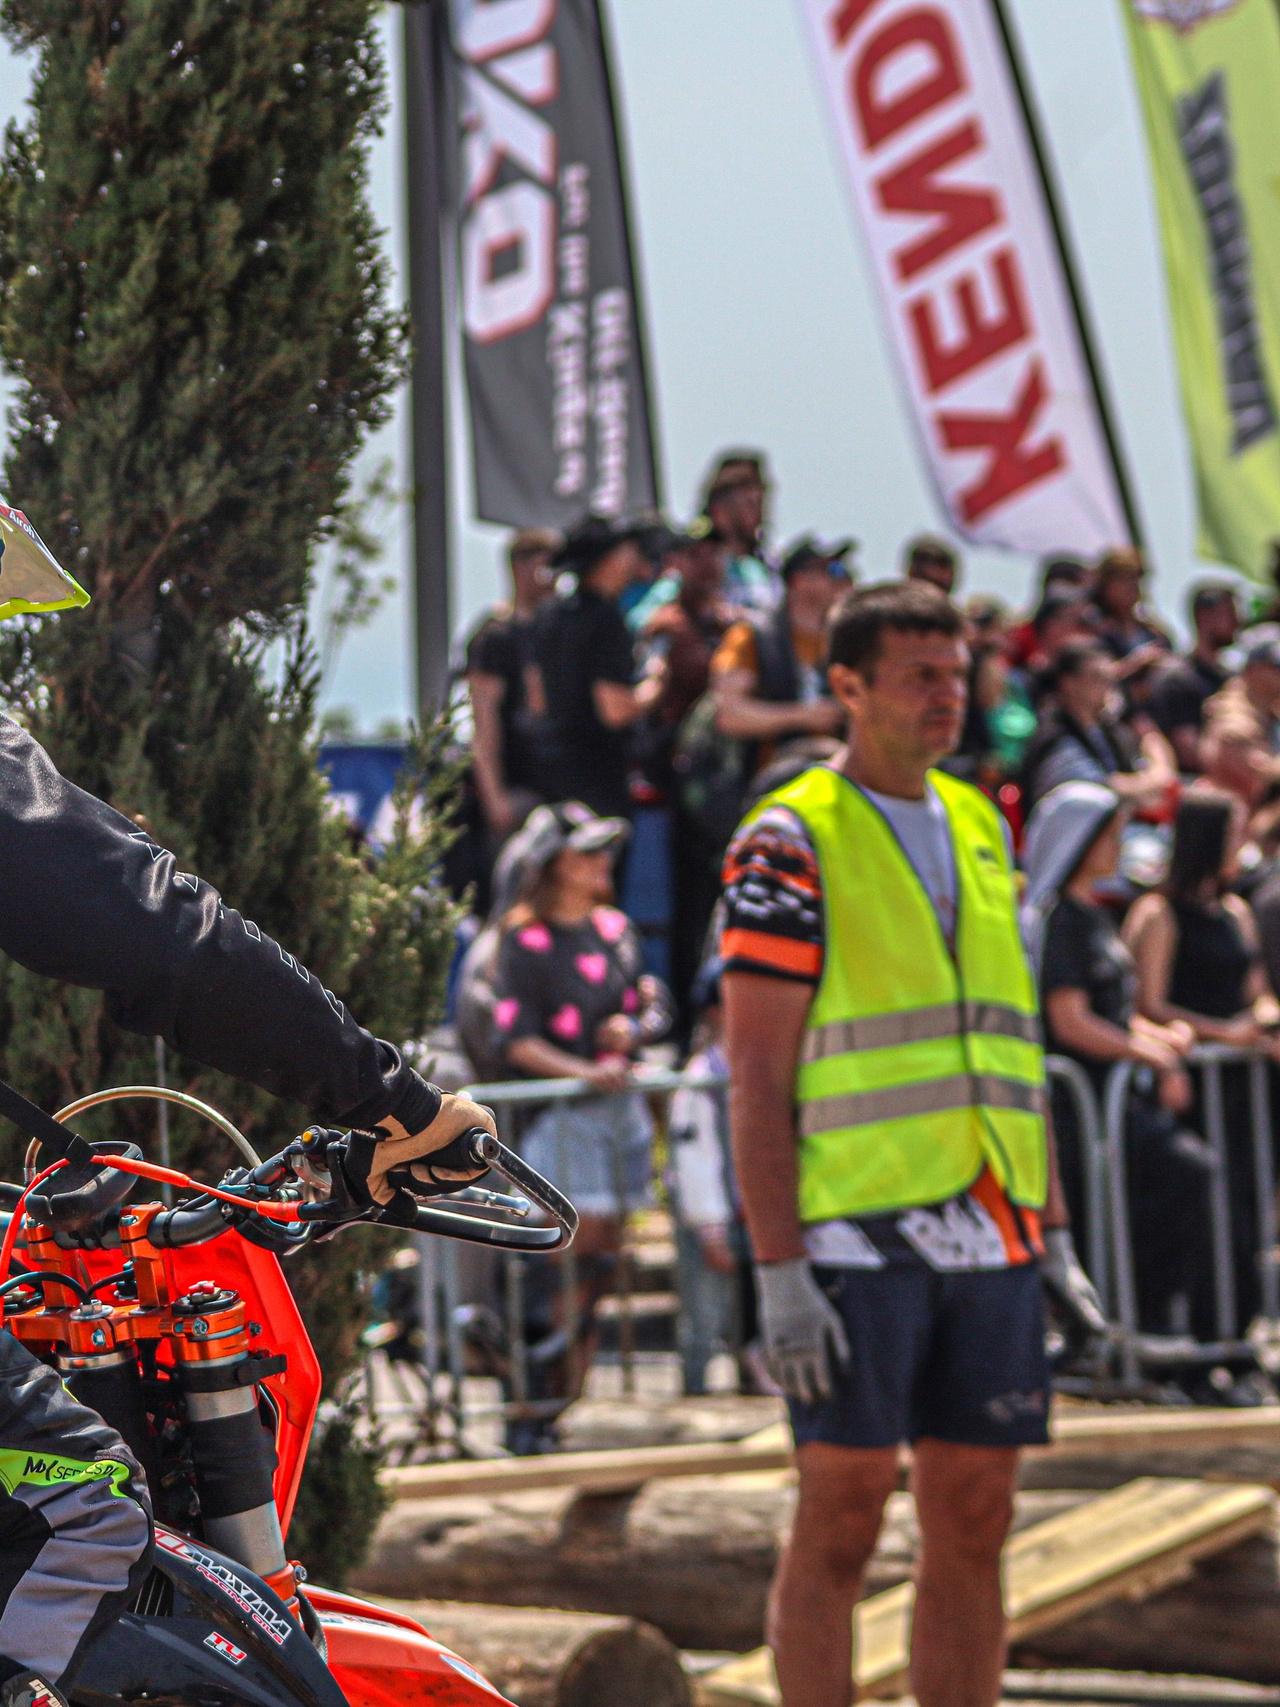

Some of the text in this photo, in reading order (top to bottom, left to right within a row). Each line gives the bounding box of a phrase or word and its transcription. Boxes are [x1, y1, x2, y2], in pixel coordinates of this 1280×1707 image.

[9, 510, 35, 538] Airoh
[196, 1565, 251, 1614] RACING
[252, 1612, 284, 1645] OILS
